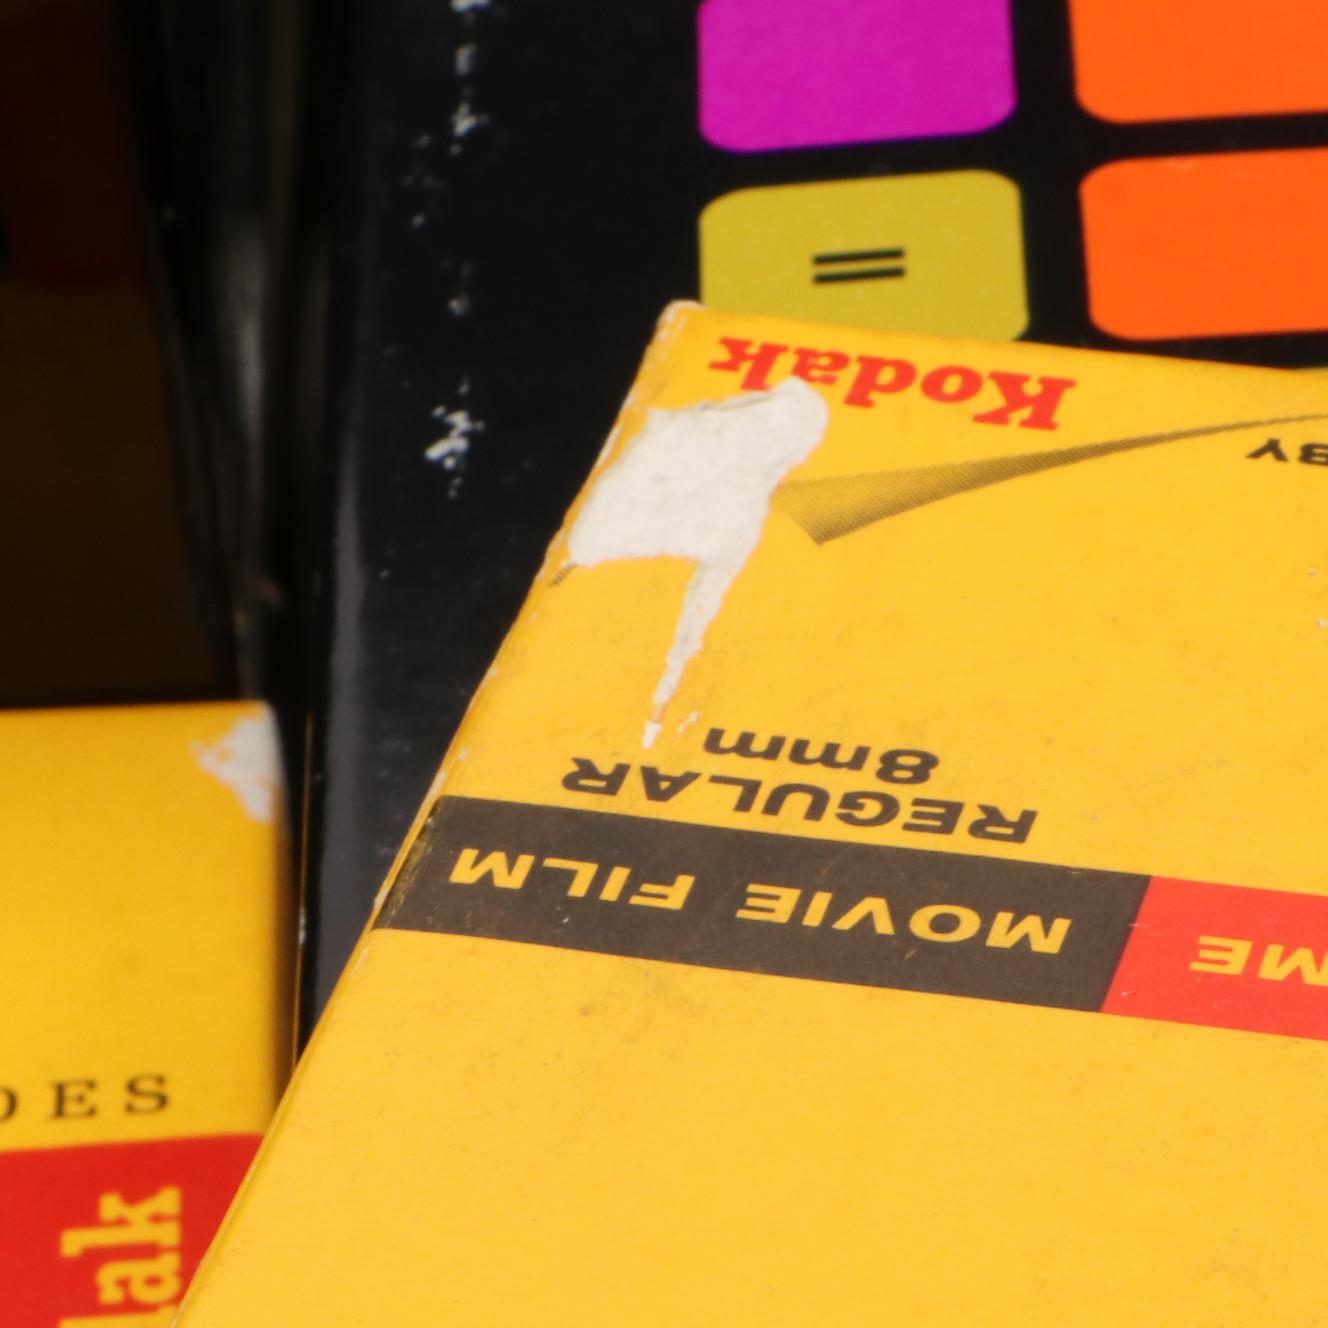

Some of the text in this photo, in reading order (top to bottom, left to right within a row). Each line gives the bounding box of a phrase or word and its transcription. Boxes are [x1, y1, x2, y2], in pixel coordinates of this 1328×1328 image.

[707, 336, 1078, 431] Kodak
[561, 757, 1038, 844] REGULAR
[703, 728, 940, 785] 8mm
[449, 847, 1073, 954] MOVIE FILM
